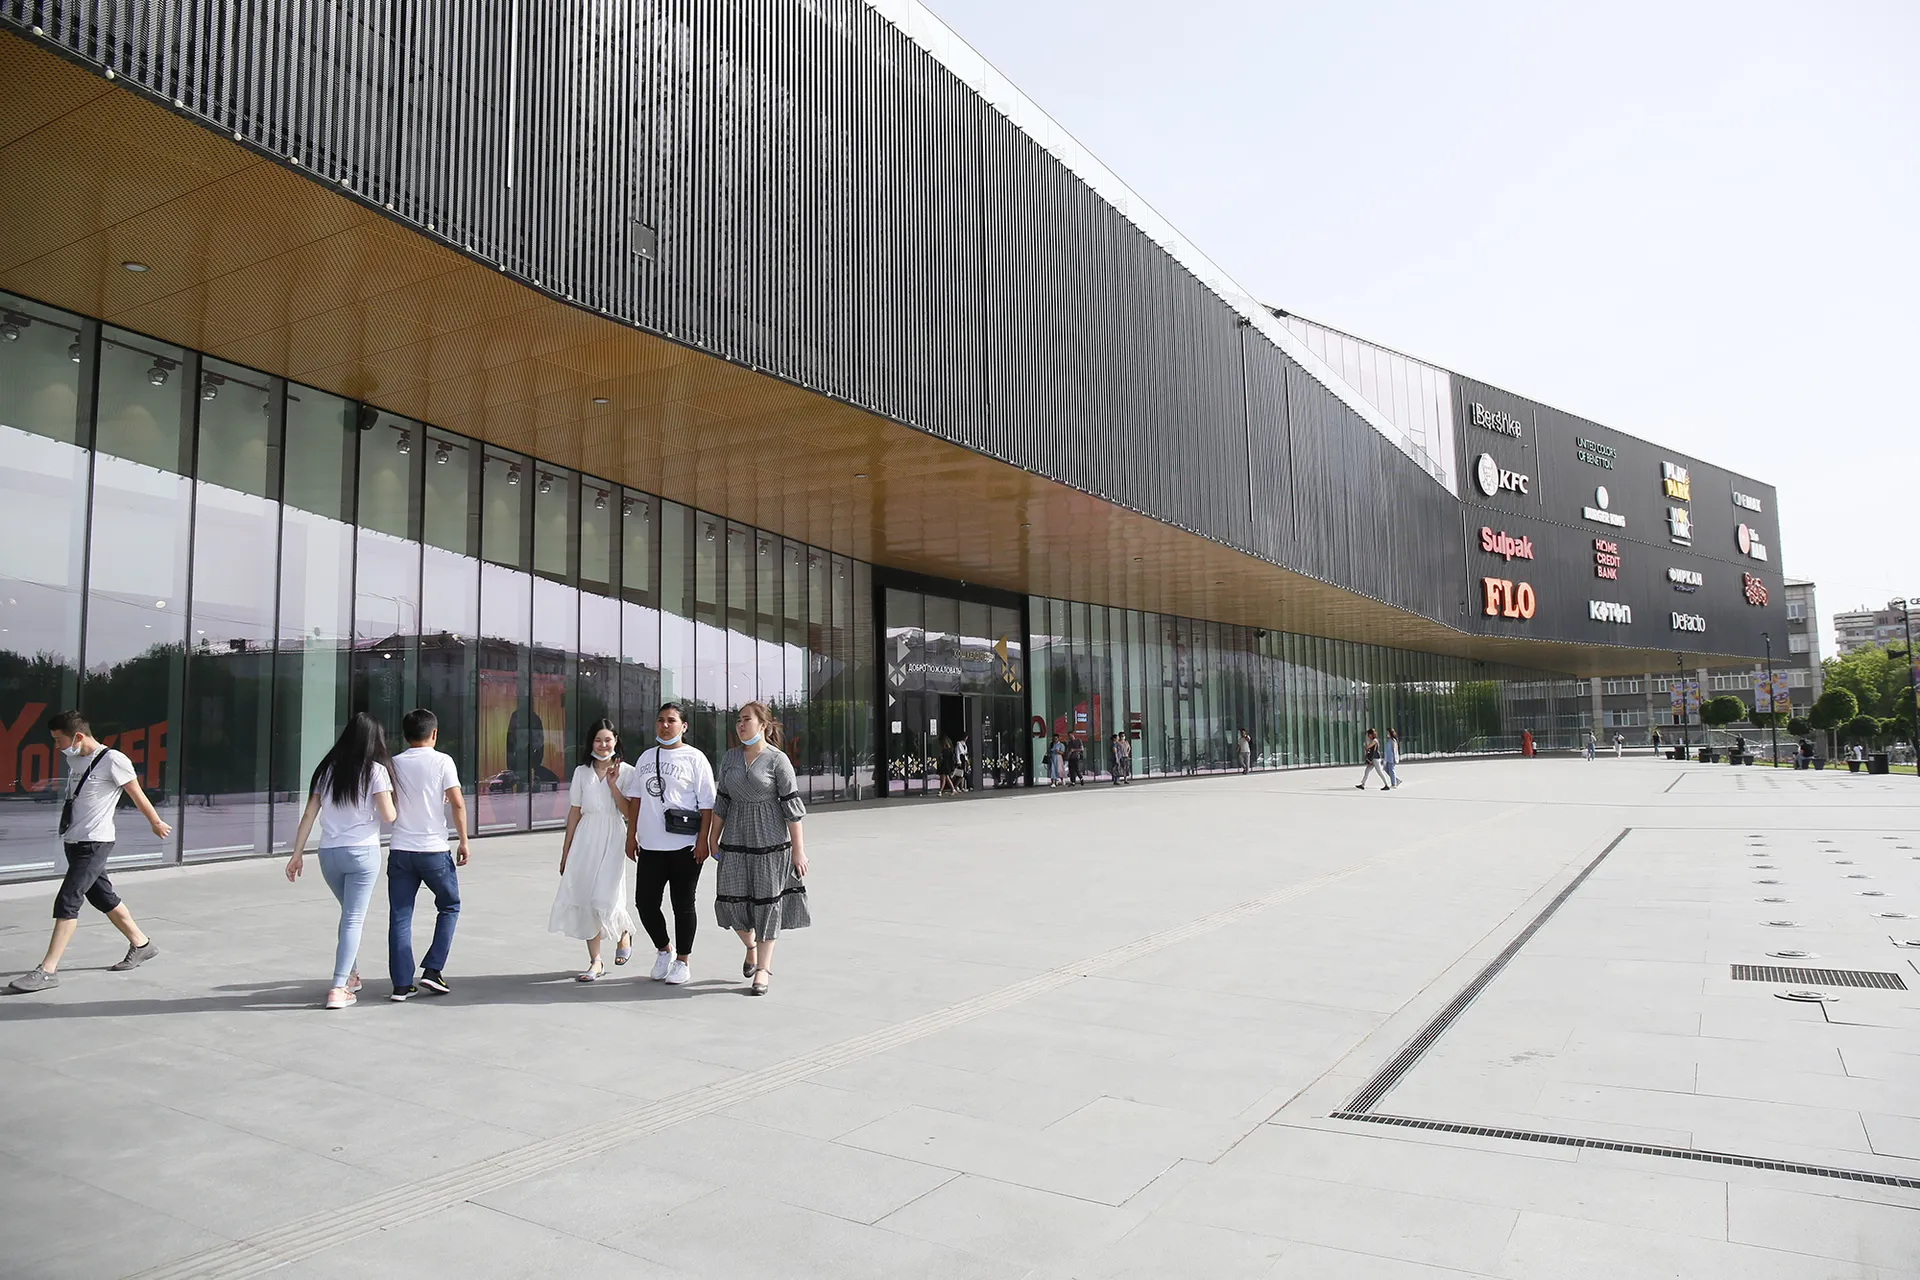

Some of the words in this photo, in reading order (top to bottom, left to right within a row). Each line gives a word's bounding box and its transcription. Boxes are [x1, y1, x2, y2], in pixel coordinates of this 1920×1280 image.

[1471, 402, 1522, 438] Bershka
[1577, 437, 1597, 452] UNITED
[1597, 443, 1617, 459] COLORS
[1578, 450, 1586, 461] OF
[1499, 468, 1529, 494] KFC
[1662, 461, 1687, 483] PLAY
[1664, 478, 1690, 500] PARK
[1481, 526, 1534, 561] Sulpak
[1595, 539, 1618, 554] HOME
[1596, 553, 1621, 567] CREDIT
[1597, 566, 1618, 580] BANK
[1482, 577, 1536, 619] FLO
[1672, 611, 1706, 632] DeFacto
[908, 663, 926, 673] ДОБРО
